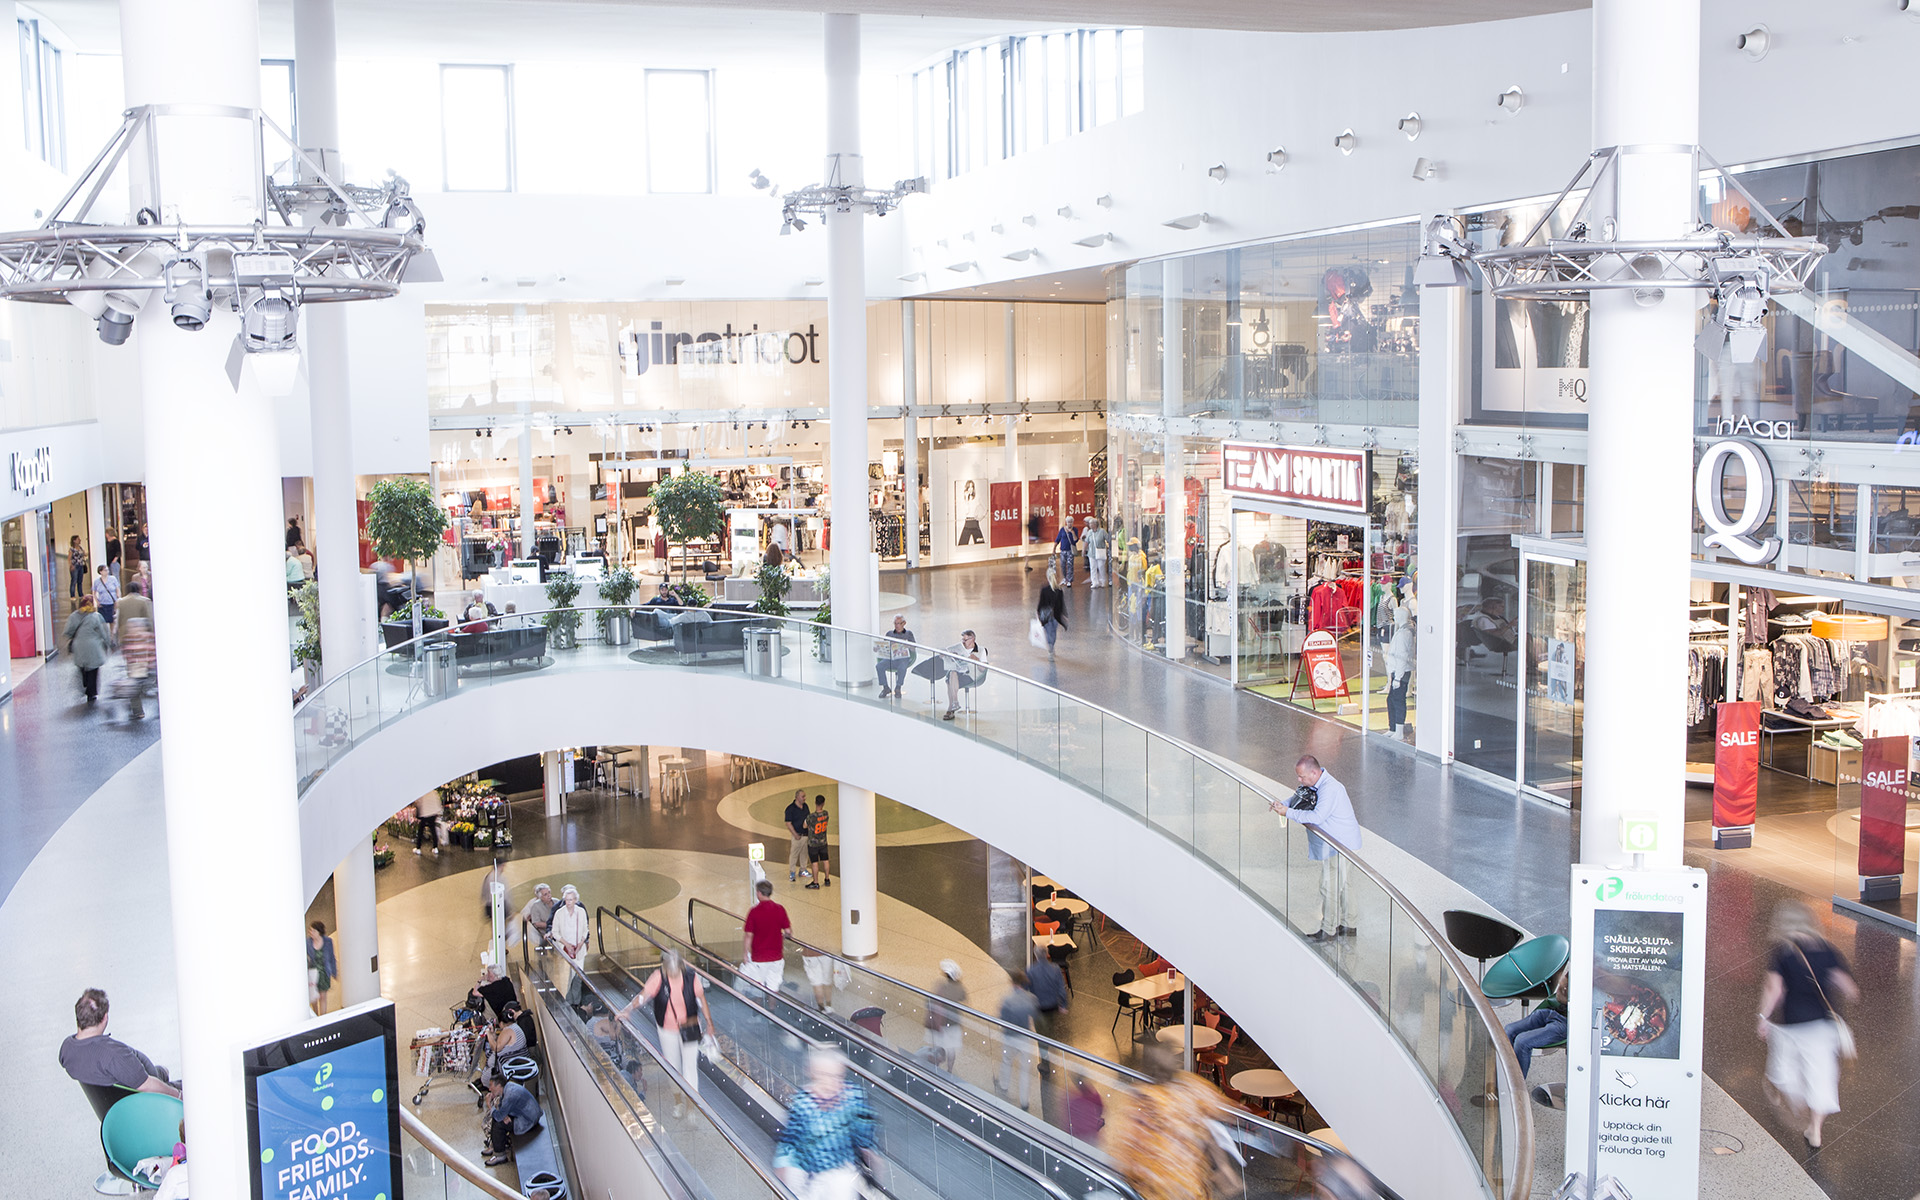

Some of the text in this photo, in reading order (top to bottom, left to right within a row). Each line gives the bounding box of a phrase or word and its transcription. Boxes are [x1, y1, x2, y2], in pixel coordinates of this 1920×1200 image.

[1558, 378, 1588, 403] MQ
[1225, 450, 1361, 502] TEAM SPORTIA
[994, 508, 1018, 521] SALE
[1069, 502, 1092, 515] SALE
[1720, 731, 1757, 747] SALE
[1866, 769, 1906, 787] SALE
[1603, 934, 1674, 946] SNÄLLA-SLUTA-
[1609, 945, 1667, 955] SKRIKA-FIKA
[1645, 1095, 1671, 1109] här
[1602, 1120, 1662, 1132] Upptäck din
[290, 1121, 361, 1162] FOOD.
[1598, 1133, 1673, 1145] igitala guide till
[1598, 1144, 1666, 1159] Frölunda Torg
[278, 1138, 375, 1191] FRIENDS.
[288, 1162, 368, 1200] FAMILY.
